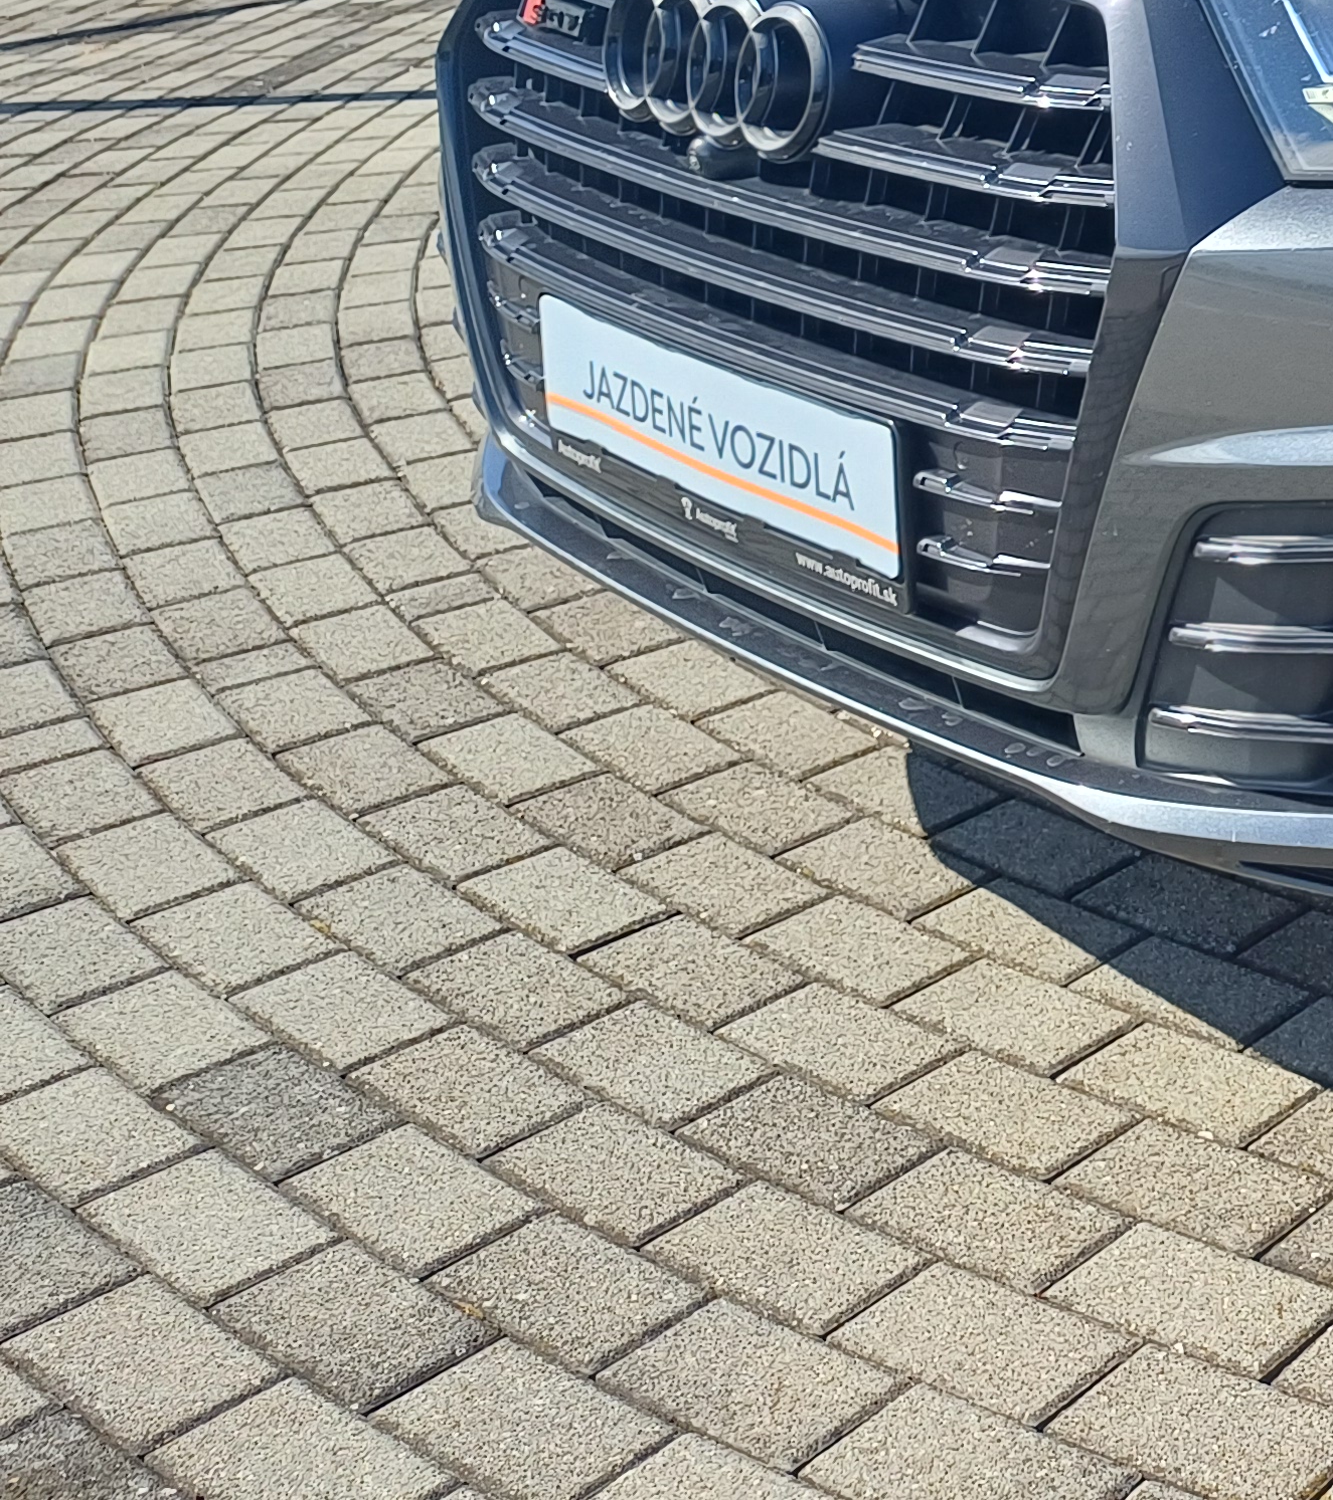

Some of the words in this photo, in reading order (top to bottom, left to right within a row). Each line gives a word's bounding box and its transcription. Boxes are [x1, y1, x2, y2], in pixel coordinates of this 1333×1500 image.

[582, 360, 705, 452] JAZDENÉ
[708, 412, 855, 512] VOZIDLÁ
[795, 551, 898, 607] www.autoprofit.sk
